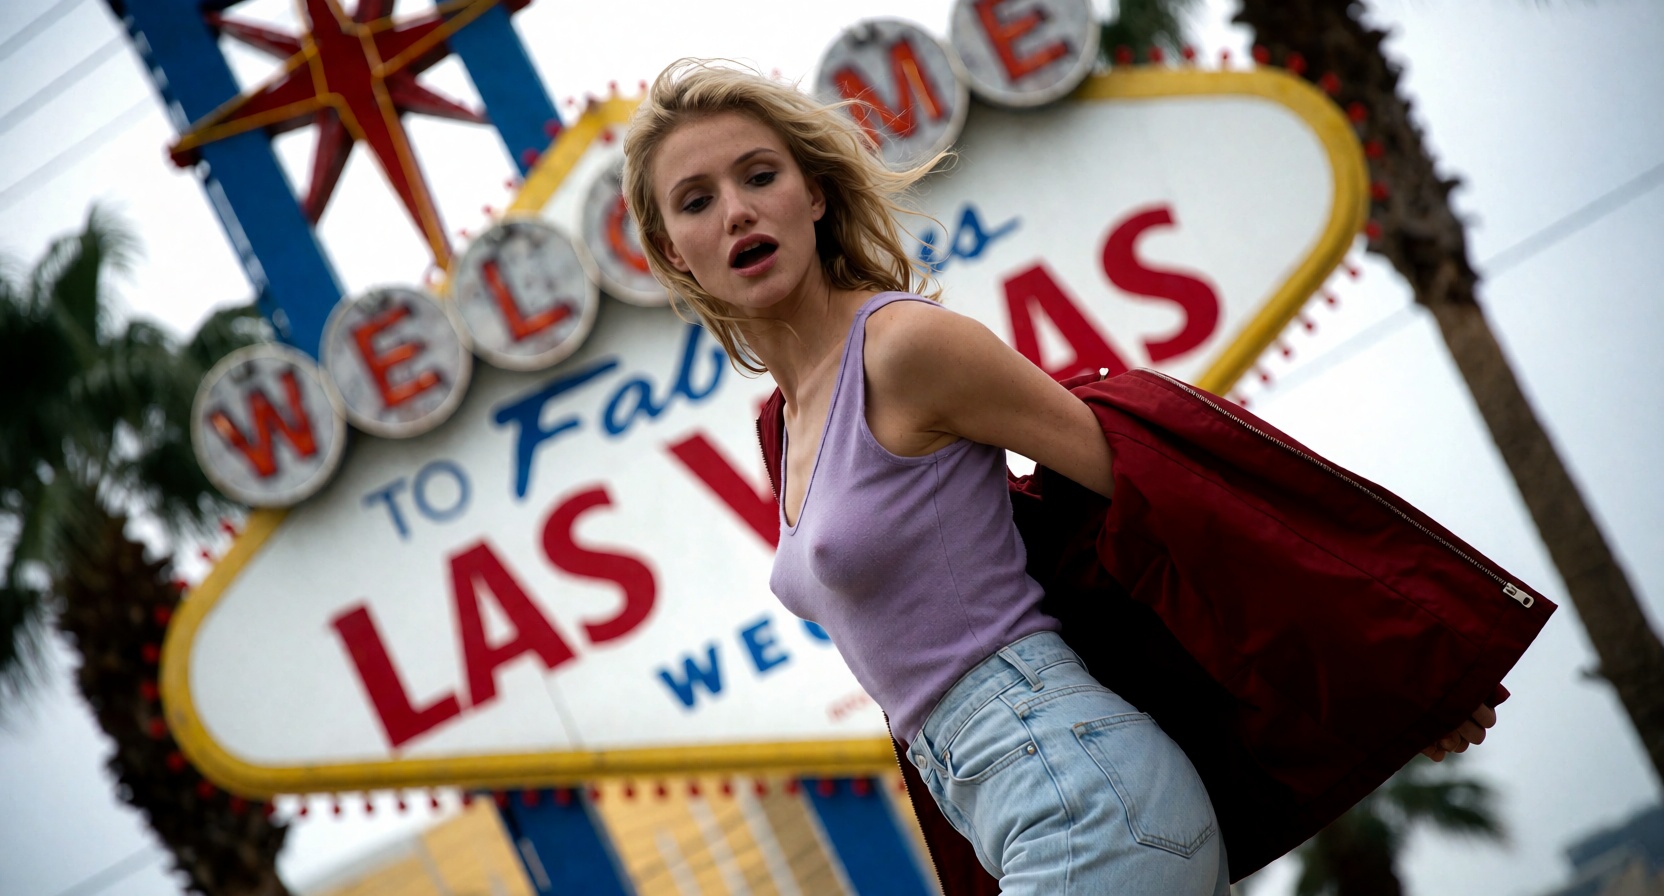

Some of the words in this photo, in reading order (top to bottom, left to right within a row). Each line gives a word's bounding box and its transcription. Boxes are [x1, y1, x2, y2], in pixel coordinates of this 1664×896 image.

[206, 0, 1070, 480] WELCME
[330, 484, 660, 750] LAS
[361, 457, 473, 540] TO
